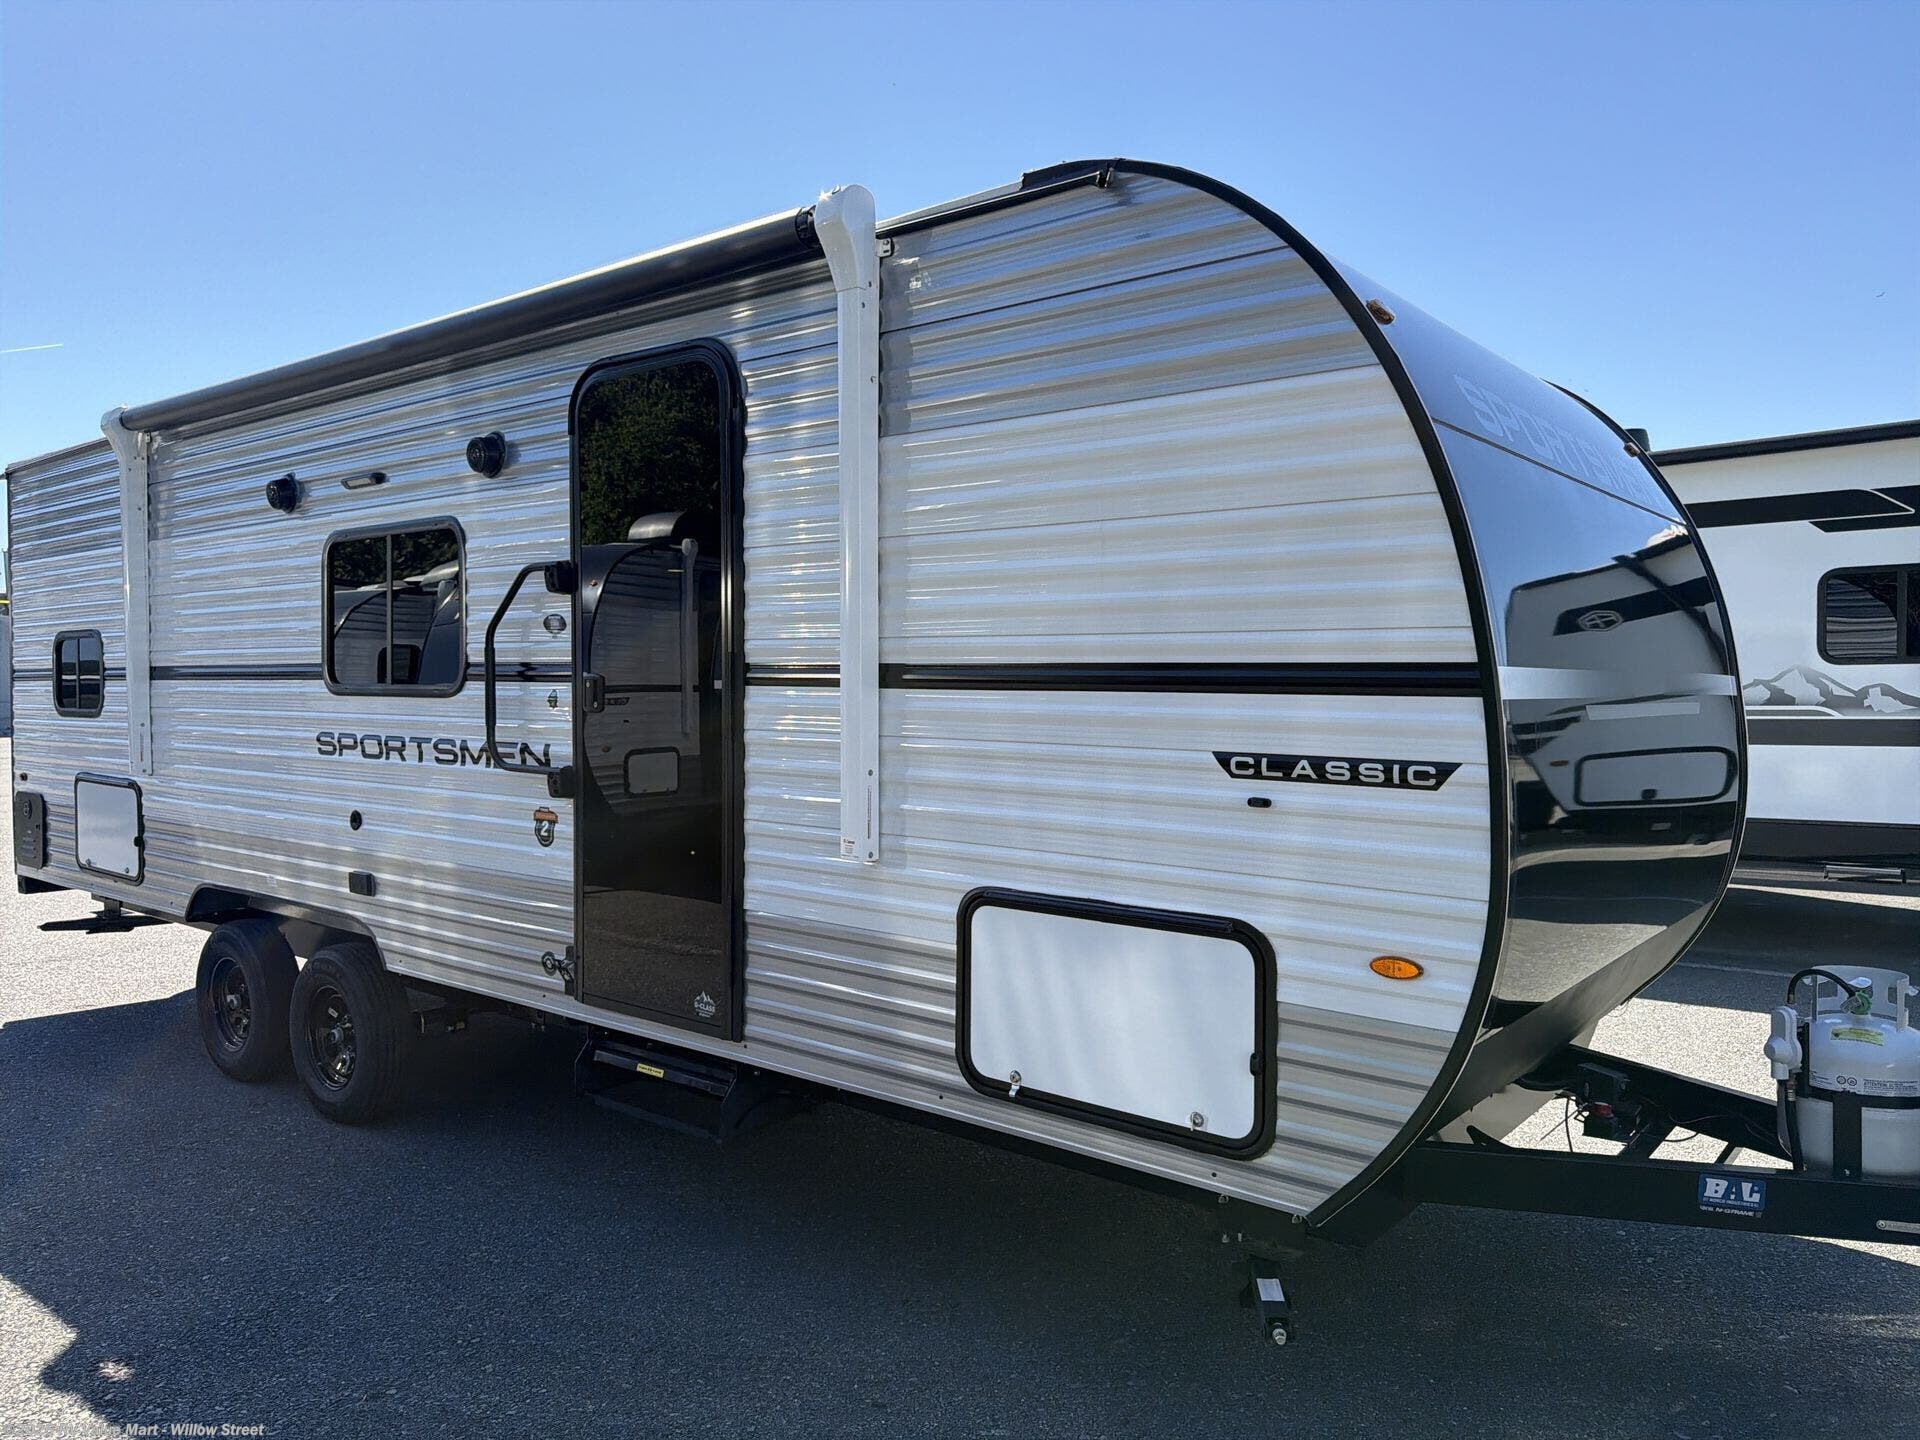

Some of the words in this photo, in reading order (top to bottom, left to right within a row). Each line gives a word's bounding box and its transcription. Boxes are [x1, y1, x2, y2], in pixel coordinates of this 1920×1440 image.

[316, 731, 551, 769] SPORTSMEN
[1229, 755, 1437, 786] CLASSIC
[540, 820, 549, 837] 2
